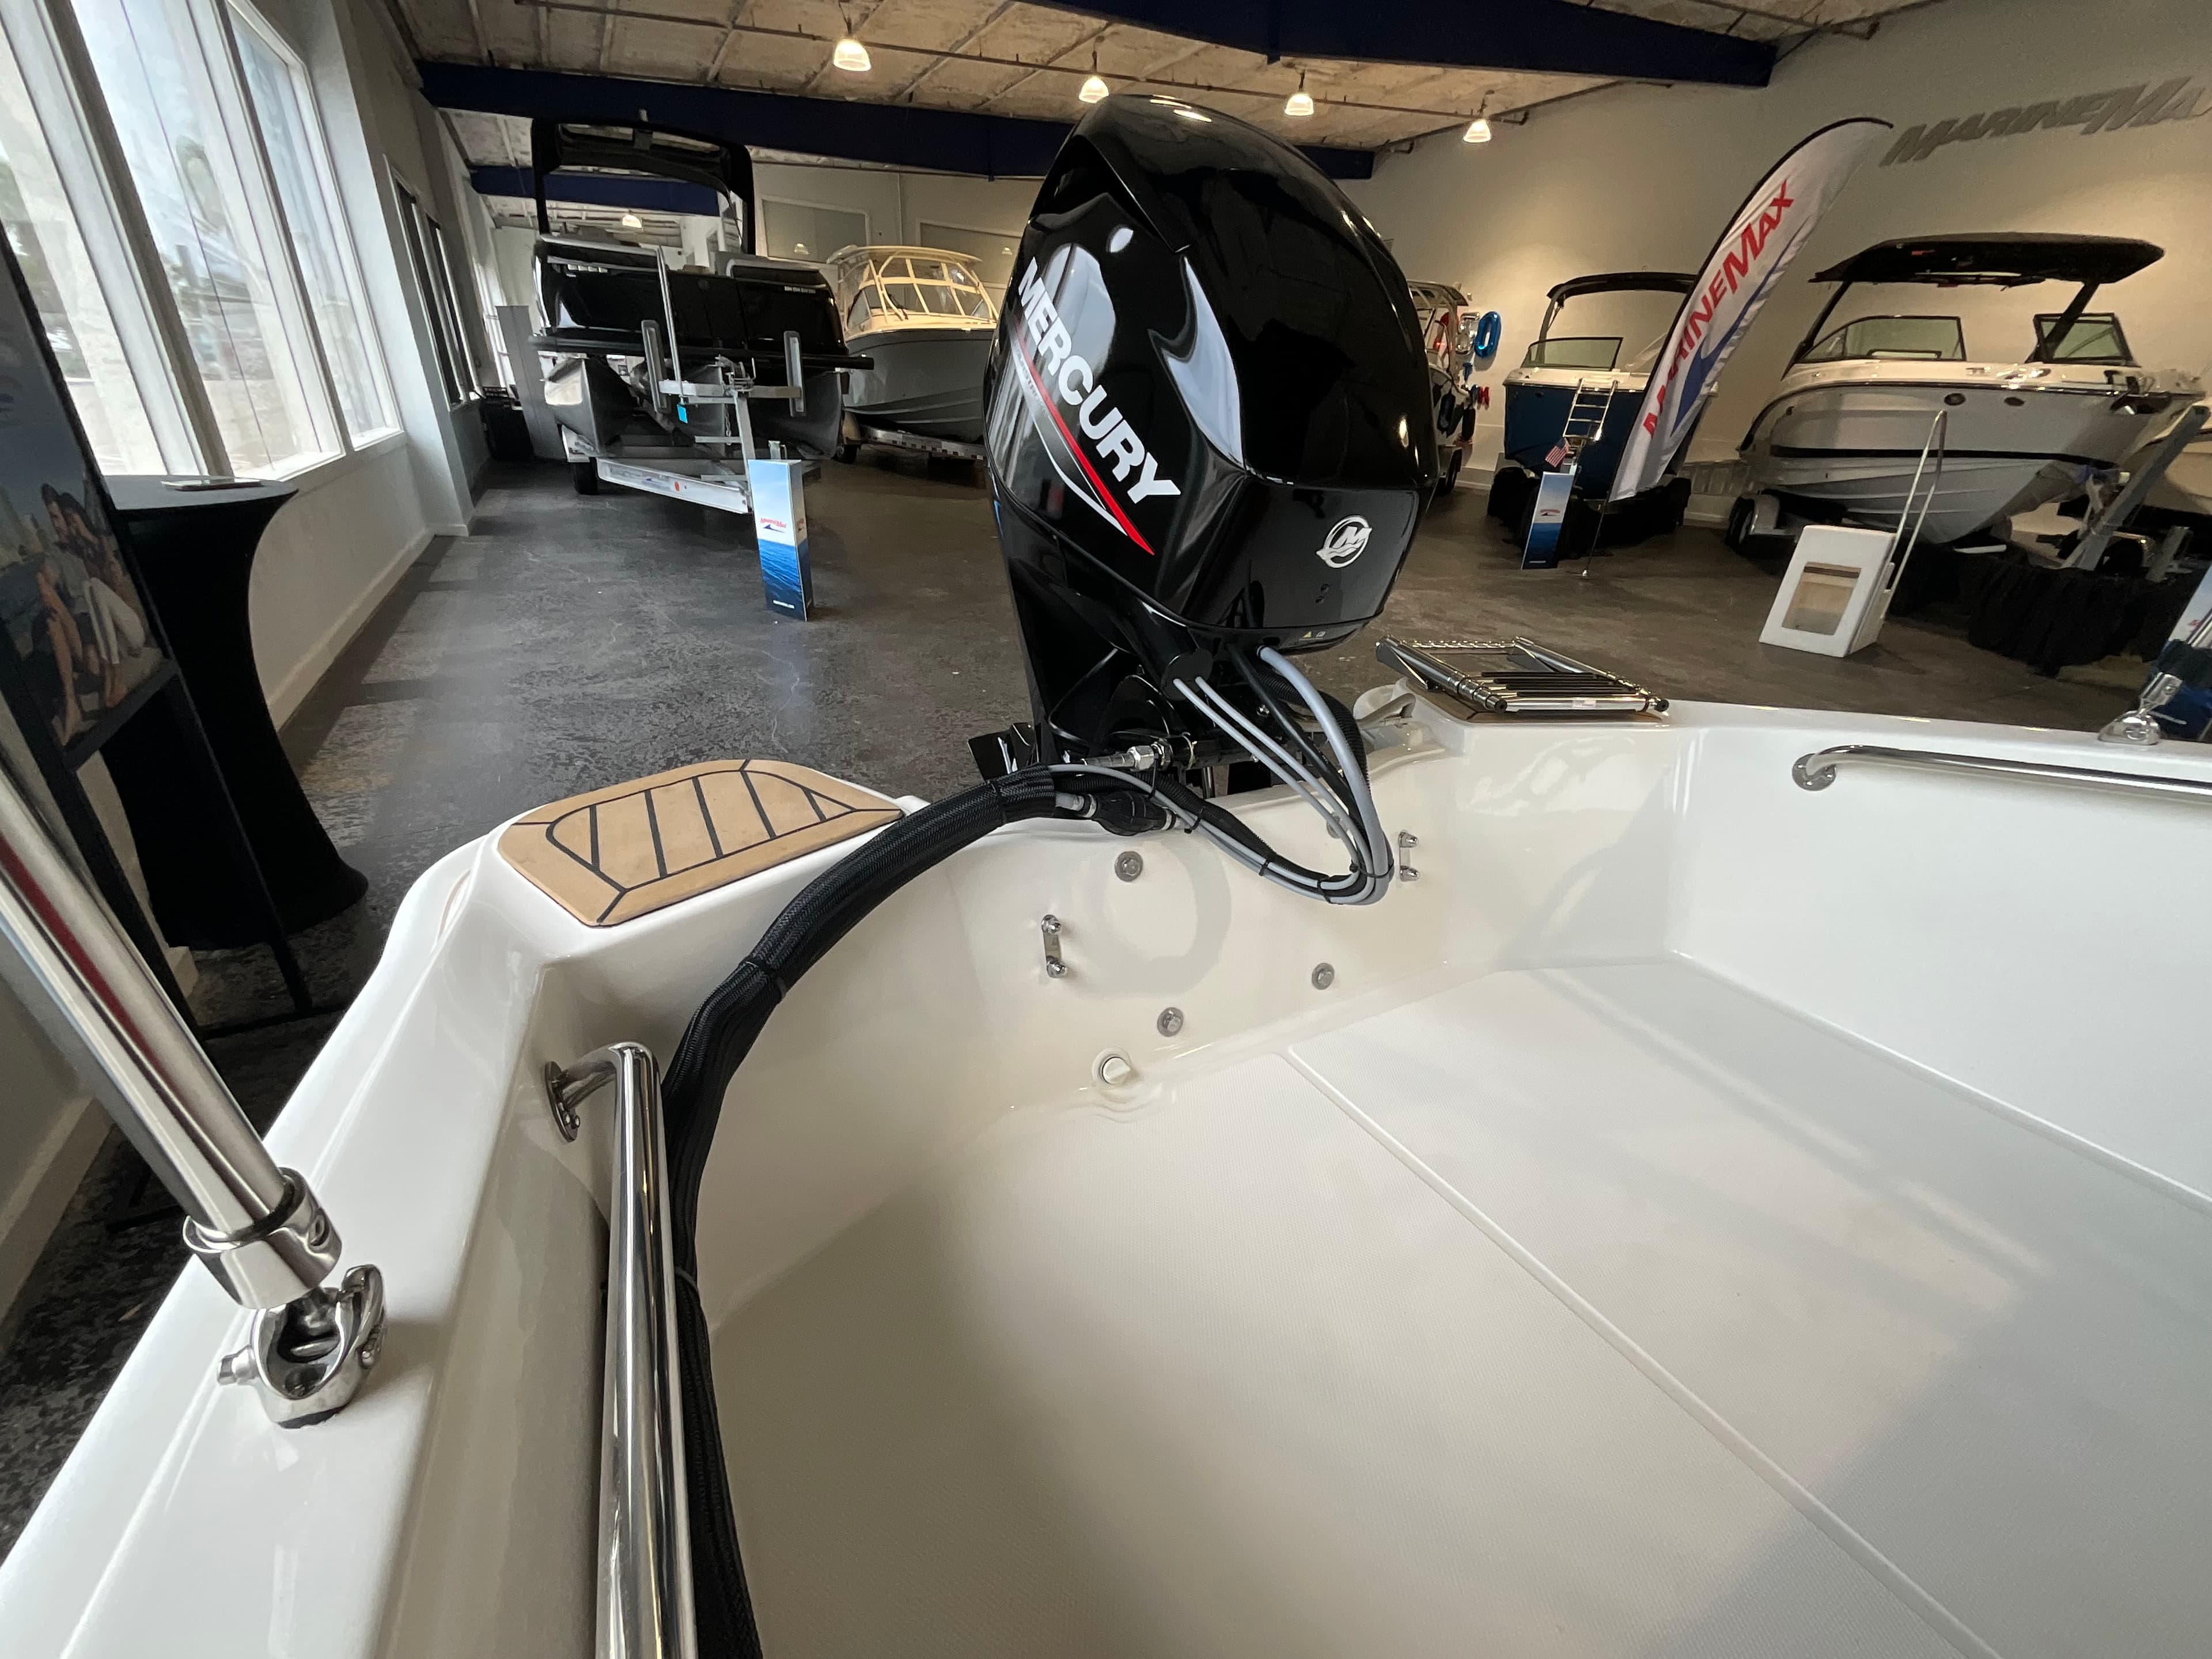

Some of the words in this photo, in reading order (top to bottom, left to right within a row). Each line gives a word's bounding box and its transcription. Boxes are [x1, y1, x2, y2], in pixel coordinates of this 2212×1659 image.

[1878, 76, 2212, 168] MARINEMA
[1018, 256, 1181, 504] MERCURY
[1643, 179, 1794, 439] MINEMAX
